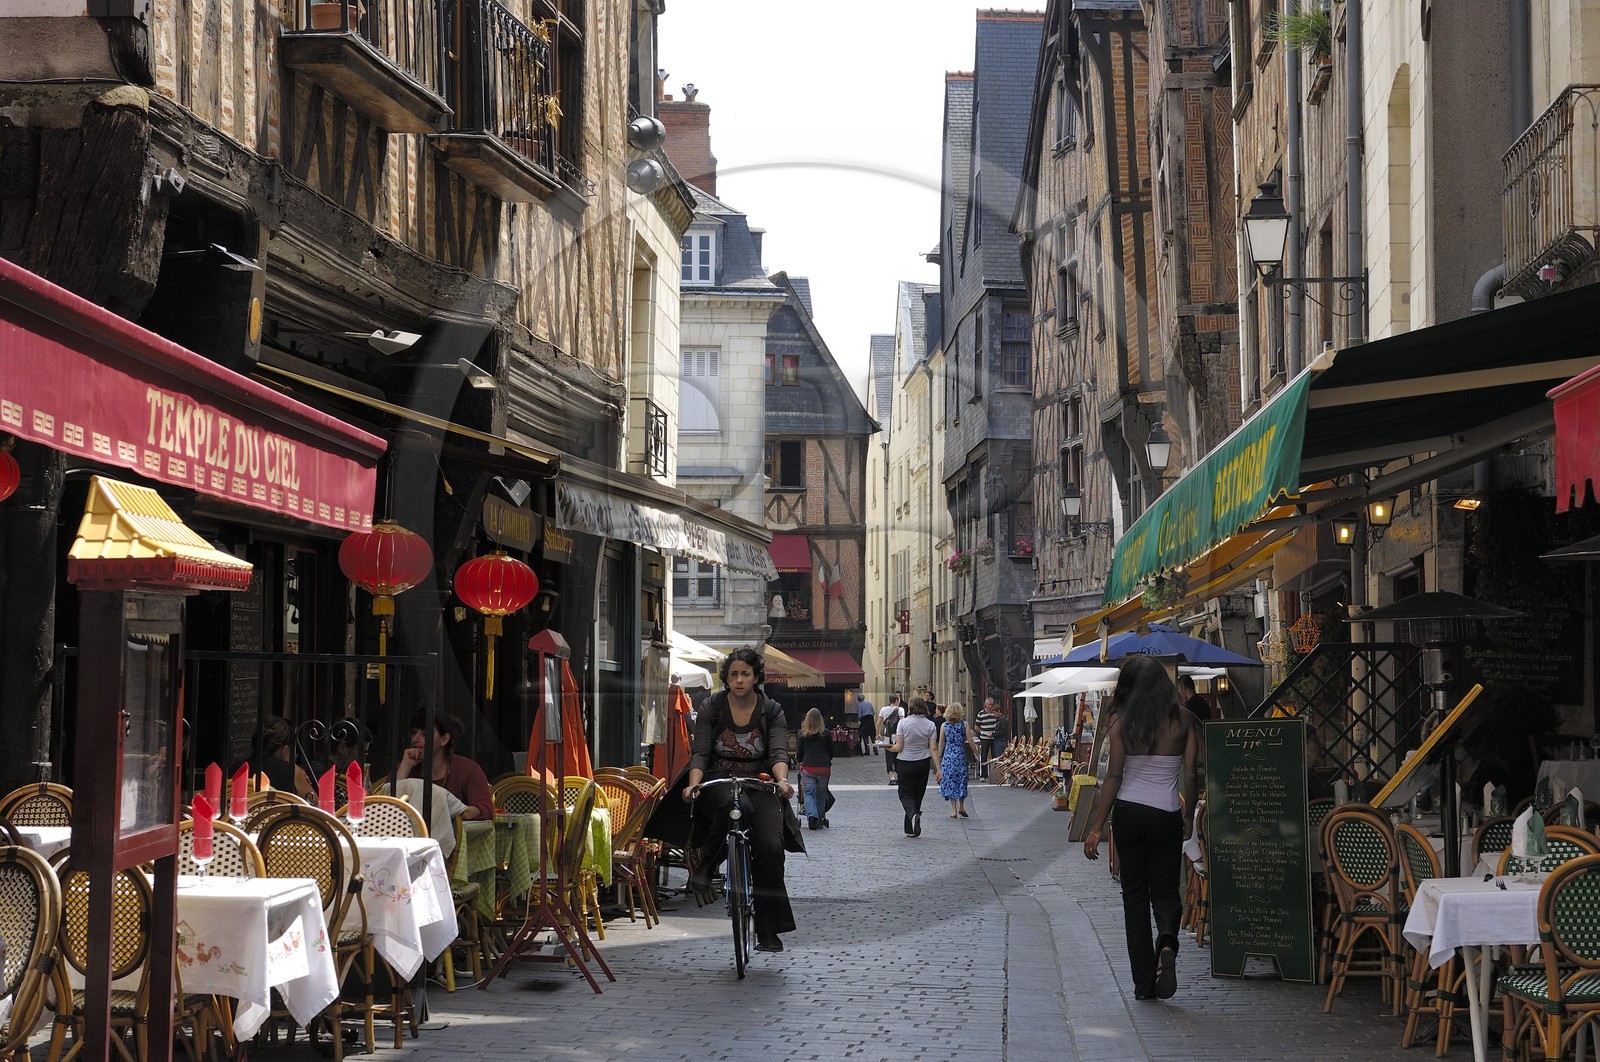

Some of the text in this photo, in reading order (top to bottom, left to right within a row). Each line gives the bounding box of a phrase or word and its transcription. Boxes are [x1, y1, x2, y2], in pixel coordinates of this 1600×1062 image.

[146, 387, 301, 491] TEMPLE DU CIEL
[1214, 424, 1277, 522] RESTAURANT
[811, 640, 837, 649] Vinci
[1226, 728, 1282, 739] MENU
